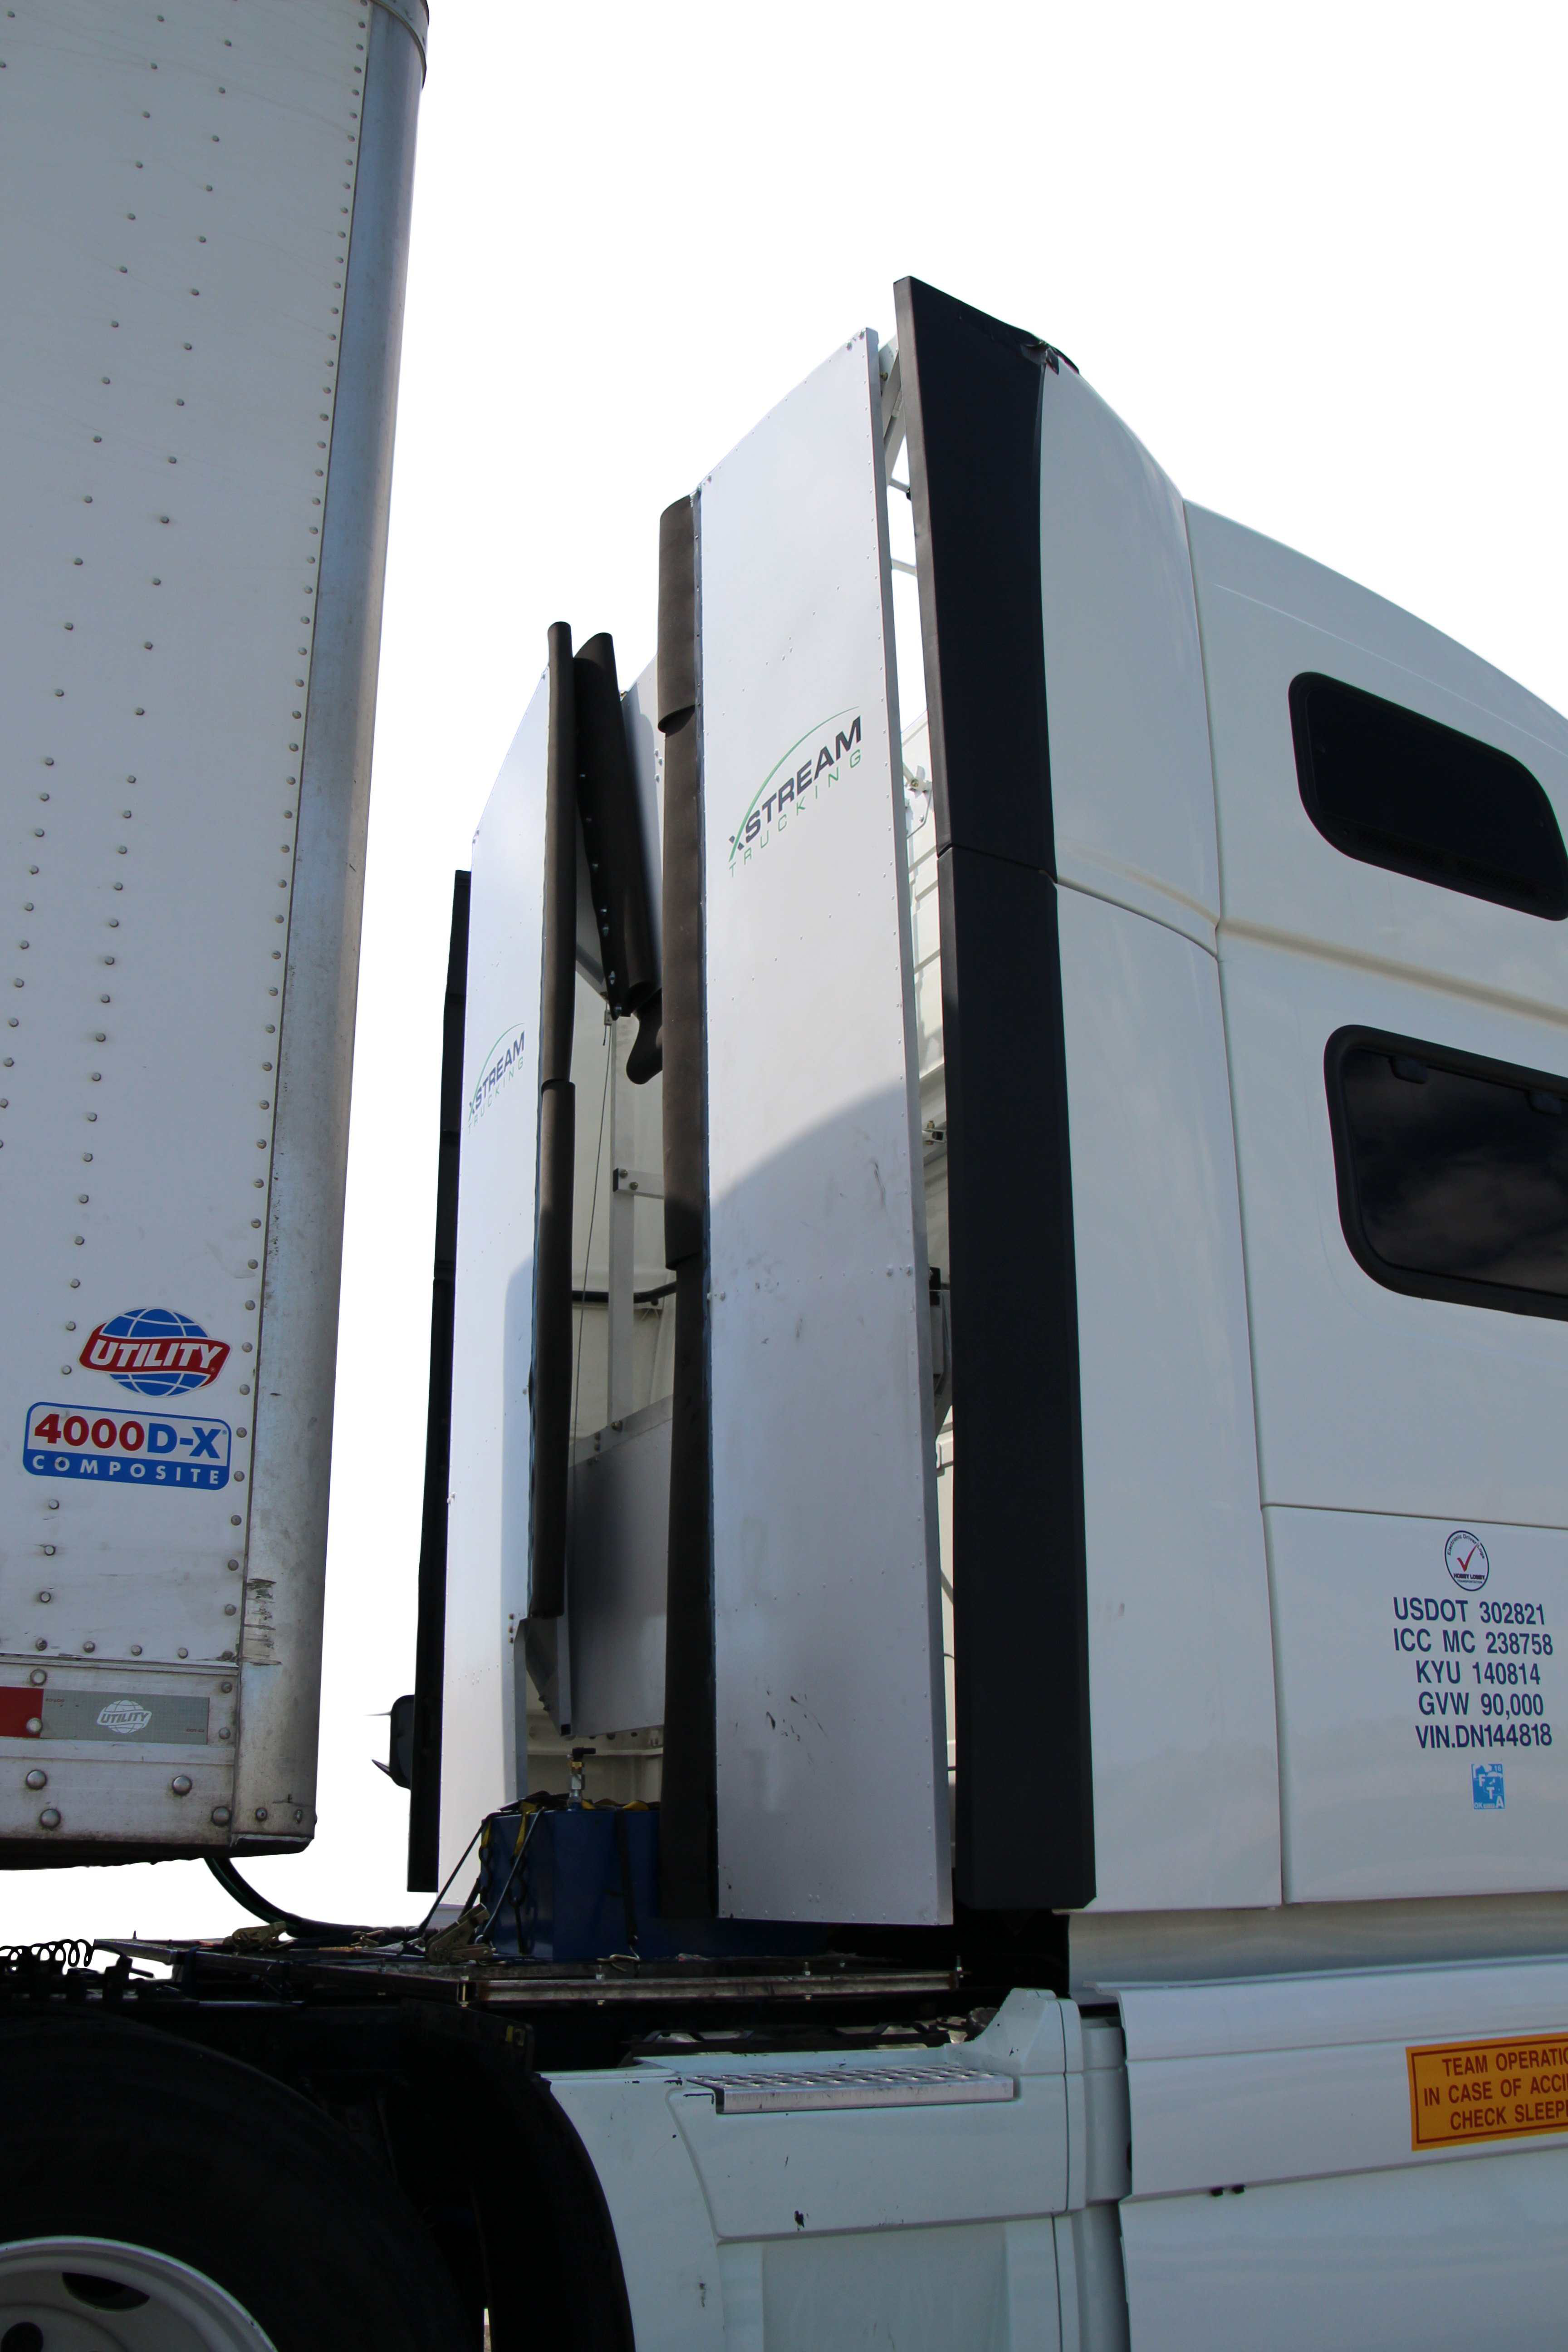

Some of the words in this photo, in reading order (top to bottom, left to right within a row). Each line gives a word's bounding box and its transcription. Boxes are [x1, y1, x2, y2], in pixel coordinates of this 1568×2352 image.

[728, 715, 862, 851] XSTREAM
[729, 749, 861, 877] TRUCKING
[89, 1339, 223, 1369] UTILITY
[34, 1413, 222, 1460] 4000D-X
[32, 1455, 219, 1485] COMPOSITE
[1393, 1597, 1468, 1622] USDOT
[1479, 1601, 1544, 1625] 302821
[1393, 1628, 1432, 1652] ICC
[1443, 1630, 1475, 1654] MC
[1485, 1632, 1553, 1656] 238758
[1416, 1660, 1461, 1684] KYU
[1472, 1661, 1541, 1686] 140814
[101, 1713, 149, 1724] UTILITY
[1418, 1691, 1470, 1716] GVW
[1480, 1693, 1544, 1720] 90,000
[1415, 1723, 1553, 1749] VIN.DN144818
[1442, 2054, 1489, 2077] TEAM
[1423, 2087, 1440, 2107] IN
[1448, 2081, 1493, 2104] CASE
[1500, 2078, 1522, 2098] OF
[1530, 2073, 1568, 2095] ACCI
[1450, 2106, 1507, 2131] CHECK
[1514, 2100, 1568, 2123] SLEEP
